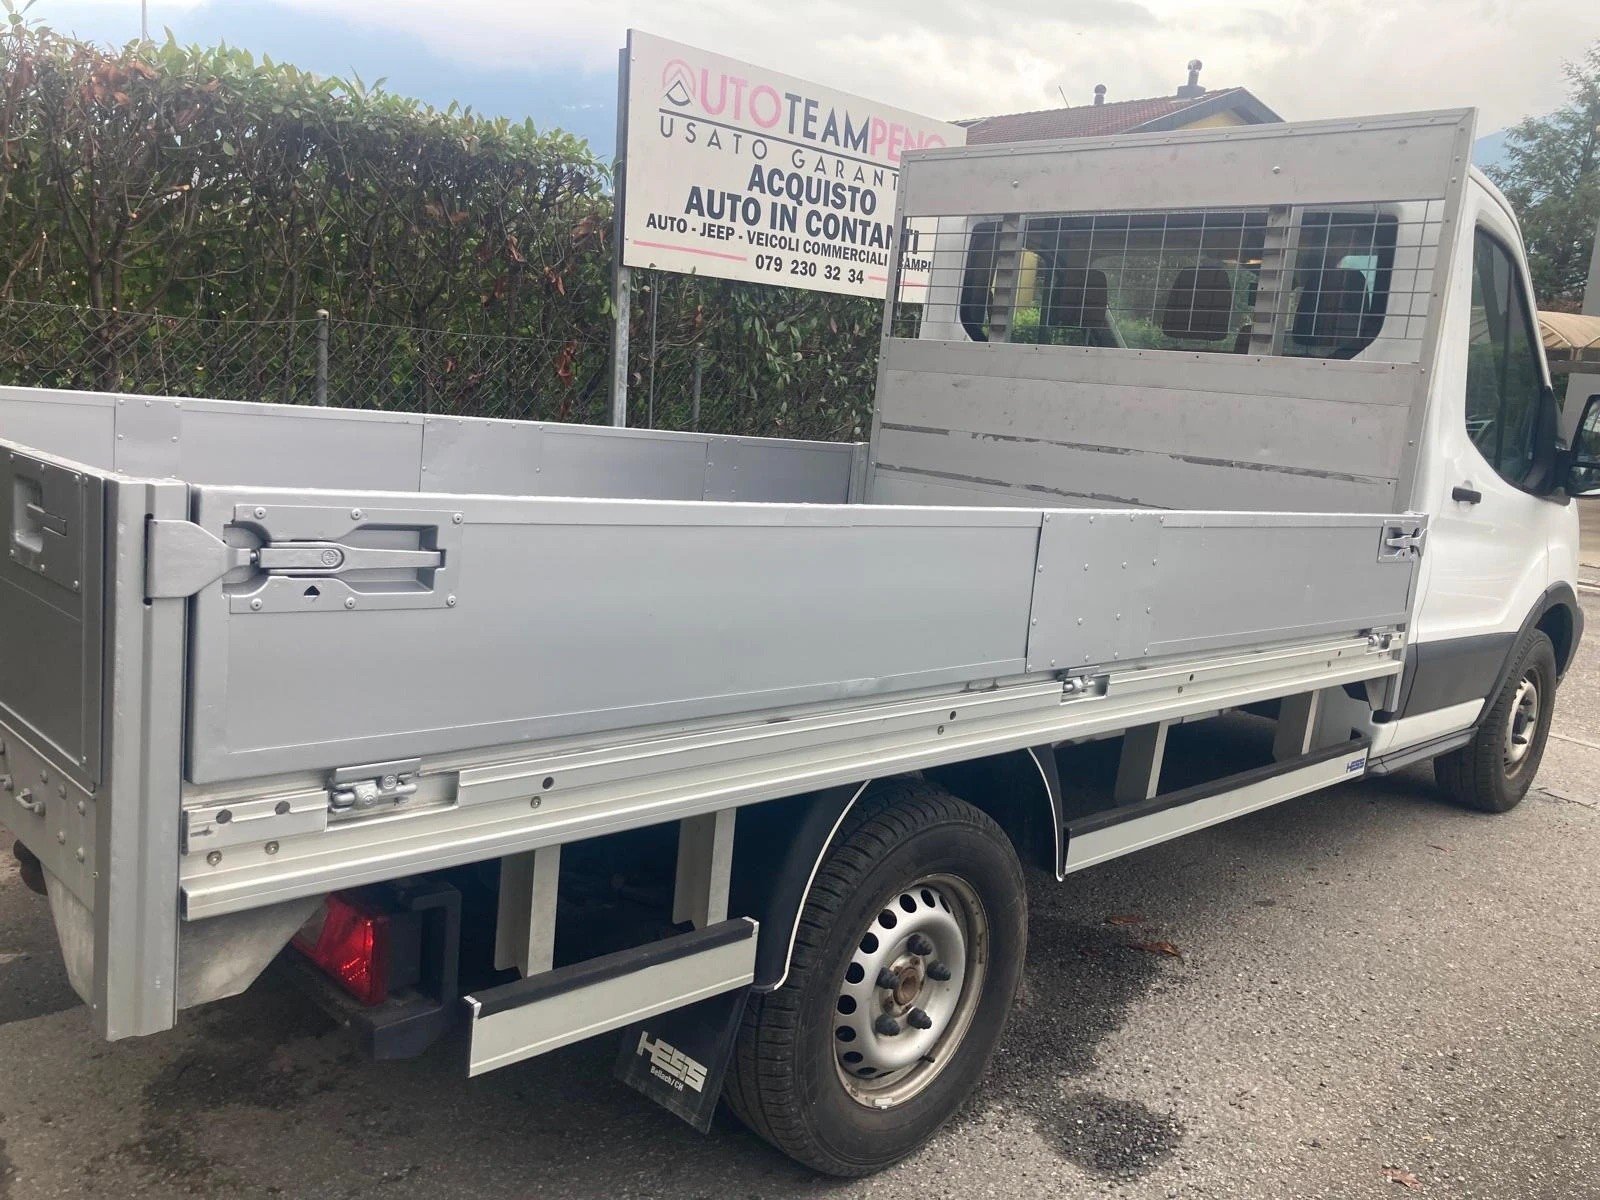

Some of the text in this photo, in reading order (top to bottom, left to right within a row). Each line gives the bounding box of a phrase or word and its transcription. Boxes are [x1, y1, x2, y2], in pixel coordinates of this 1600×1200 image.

[660, 115, 768, 160] USATO
[684, 185, 761, 226] AUTO
[769, 201, 798, 233] IN
[747, 163, 877, 216] ACQUISTO
[646, 213, 688, 233] AUTO
[699, 222, 735, 241] JEEP
[747, 230, 800, 252] VEICOLI
[803, 240, 888, 267] COMMERCIALI
[755, 254, 864, 284] 079 230 32 34
[636, 1030, 708, 1093] HESS
